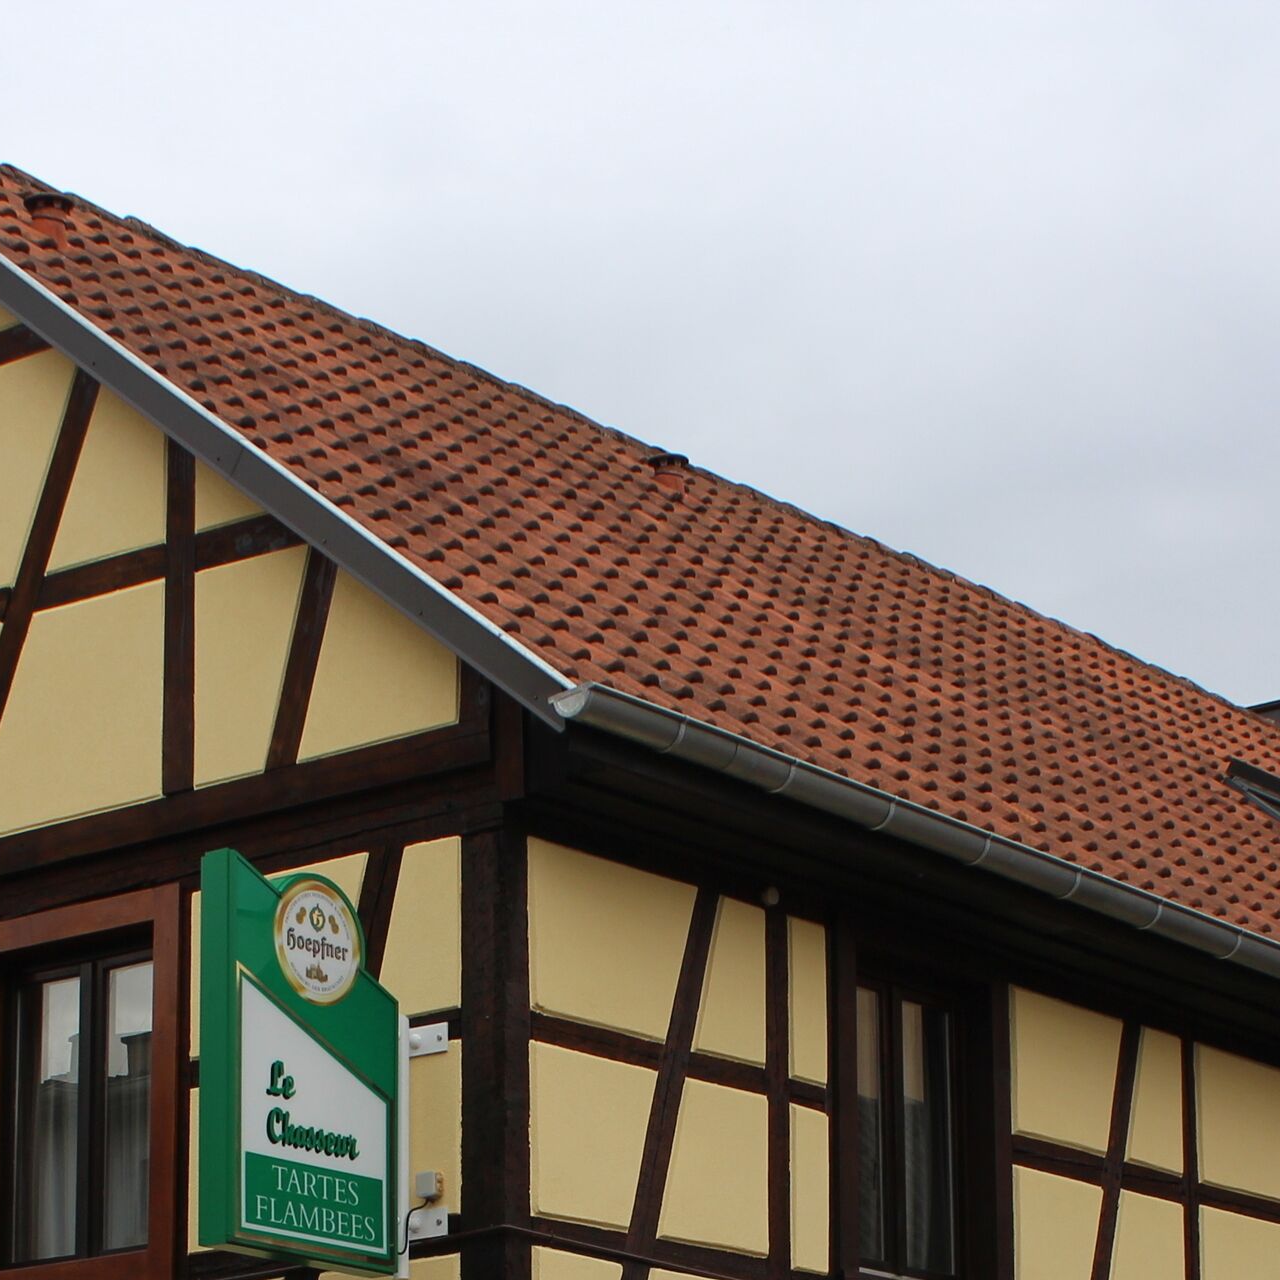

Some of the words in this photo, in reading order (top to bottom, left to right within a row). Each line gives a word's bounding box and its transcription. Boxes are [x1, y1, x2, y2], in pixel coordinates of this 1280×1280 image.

[266, 1060, 296, 1100] Le
[266, 1107, 360, 1160] Chasseur
[272, 1165, 360, 1206] TARTES
[255, 1195, 376, 1242] FLAMBEES
